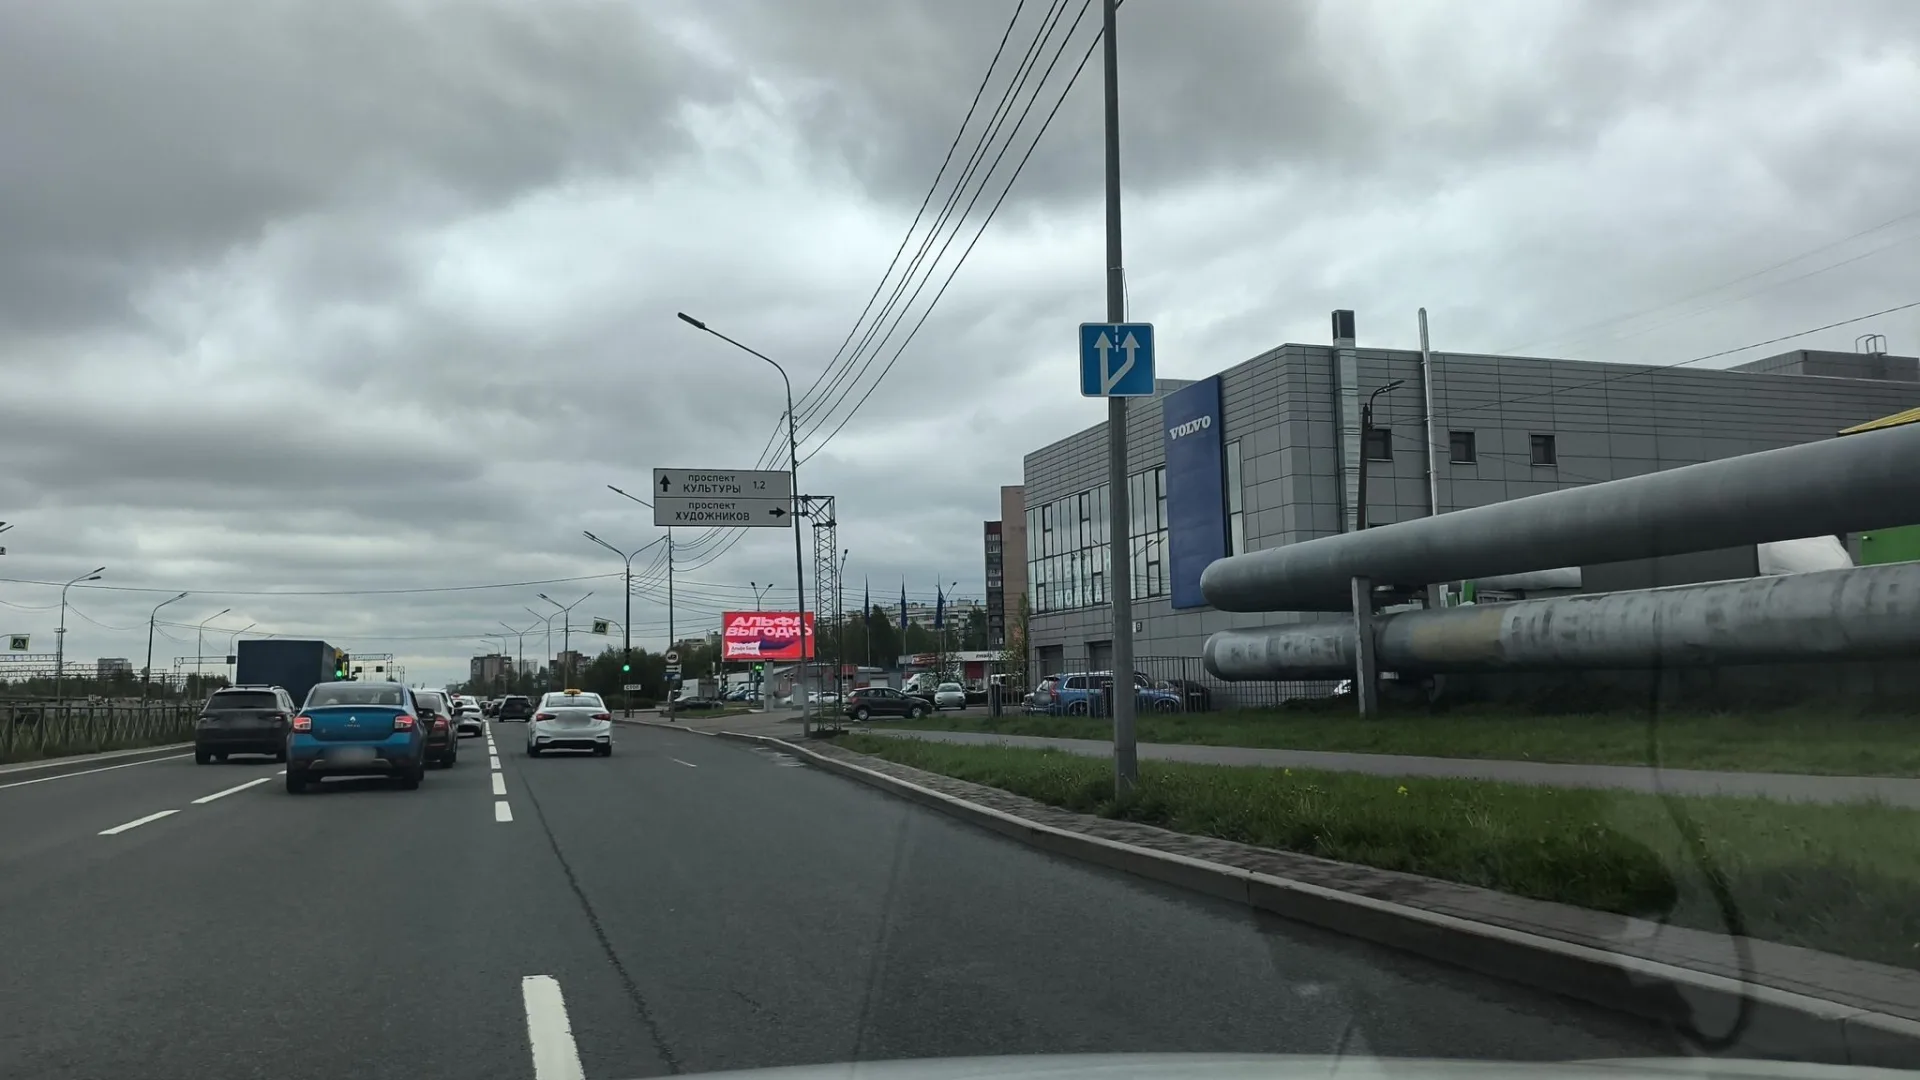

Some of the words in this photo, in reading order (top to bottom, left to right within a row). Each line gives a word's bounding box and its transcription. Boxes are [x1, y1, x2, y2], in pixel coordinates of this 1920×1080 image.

[1170, 415, 1211, 440] VOLVO
[688, 474, 735, 484] проспект
[683, 484, 741, 494] КУЛЬТУРЫ
[688, 502, 736, 510] проспект
[675, 512, 750, 521] ХУДОЖНИКОВ
[1036, 549, 1112, 583] ДЕТЕЙЛИН
[730, 616, 808, 627] АЛЬФА
[725, 626, 813, 638] ВЫГОДНО
